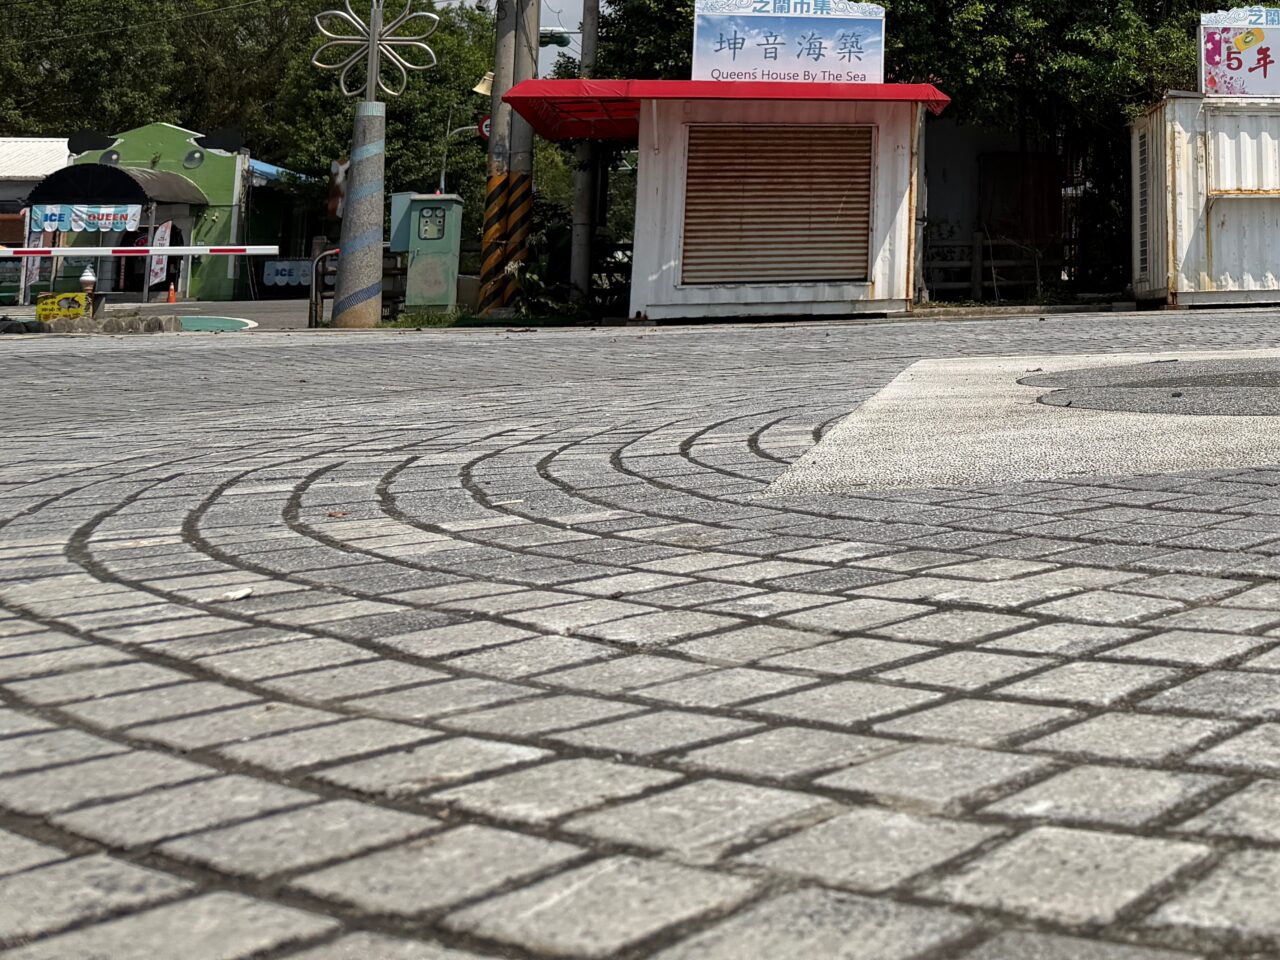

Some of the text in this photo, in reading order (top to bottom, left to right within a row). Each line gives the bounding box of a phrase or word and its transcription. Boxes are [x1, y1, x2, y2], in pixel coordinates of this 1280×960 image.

[714, 29, 865, 63] 坤音海築
[761, 69, 800, 81] House
[803, 70, 818, 82] By
[821, 70, 843, 82] The
[846, 71, 867, 82] Sea
[43, 213, 128, 222] ICE QUEEN
